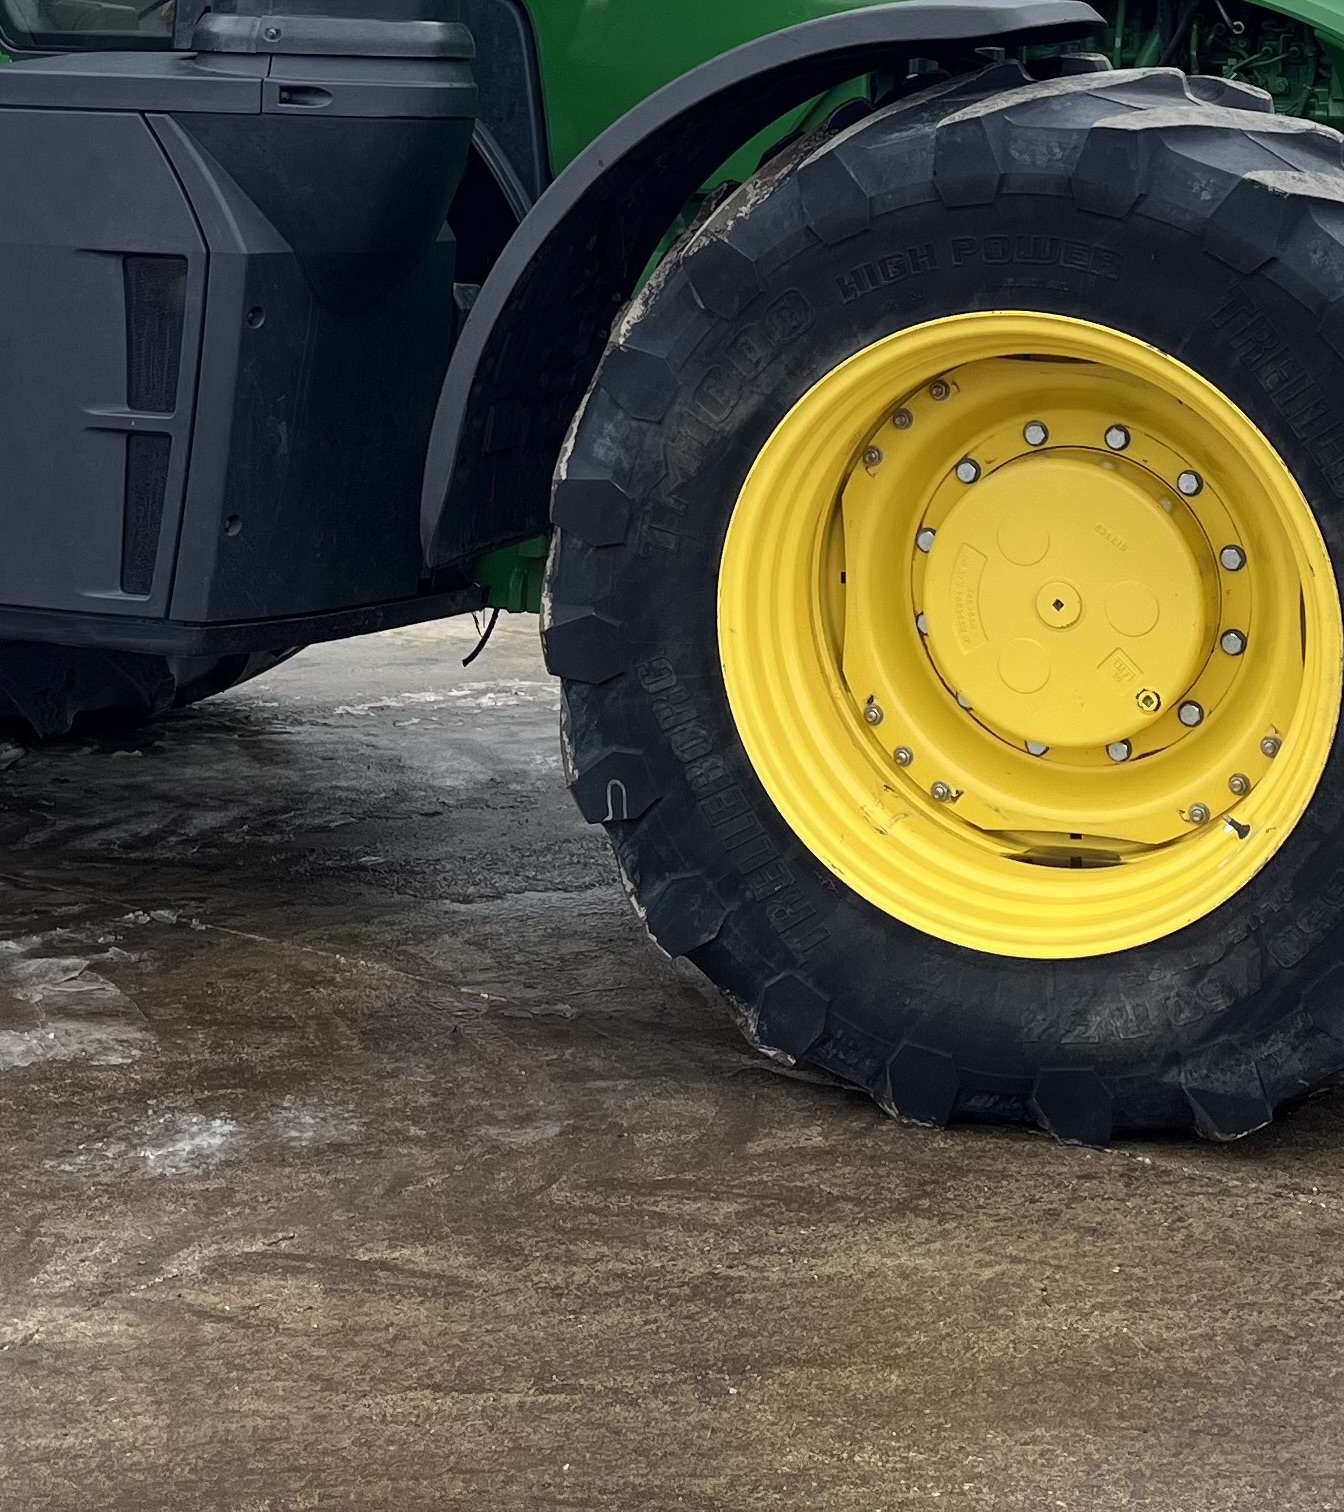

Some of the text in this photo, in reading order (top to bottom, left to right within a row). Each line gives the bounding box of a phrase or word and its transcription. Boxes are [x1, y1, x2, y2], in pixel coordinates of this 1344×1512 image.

[837, 242, 939, 302] HIGH
[950, 234, 1123, 278] POWER
[640, 656, 830, 966] TRELLEBORG
